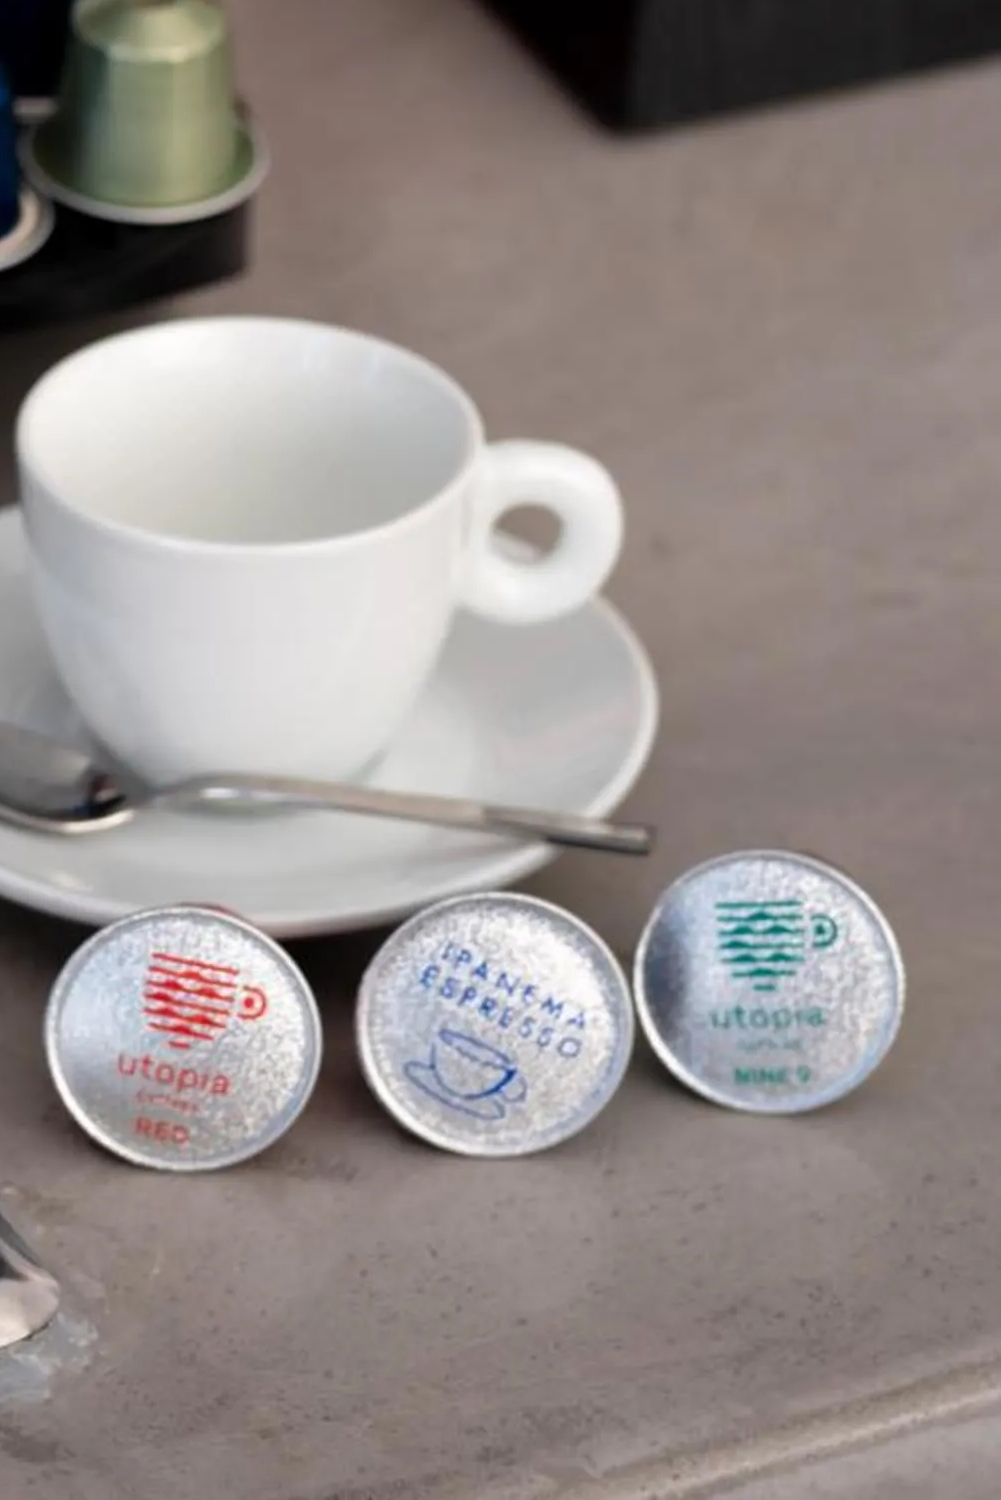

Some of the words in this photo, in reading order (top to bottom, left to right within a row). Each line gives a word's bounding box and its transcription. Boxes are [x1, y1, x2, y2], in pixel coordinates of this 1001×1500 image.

[441, 940, 587, 1030] IPANEMA
[419, 964, 583, 1059] ESPRESSO
[710, 1004, 827, 1032] utopia
[117, 1053, 232, 1096] utopia
[133, 1115, 191, 1146] RED
